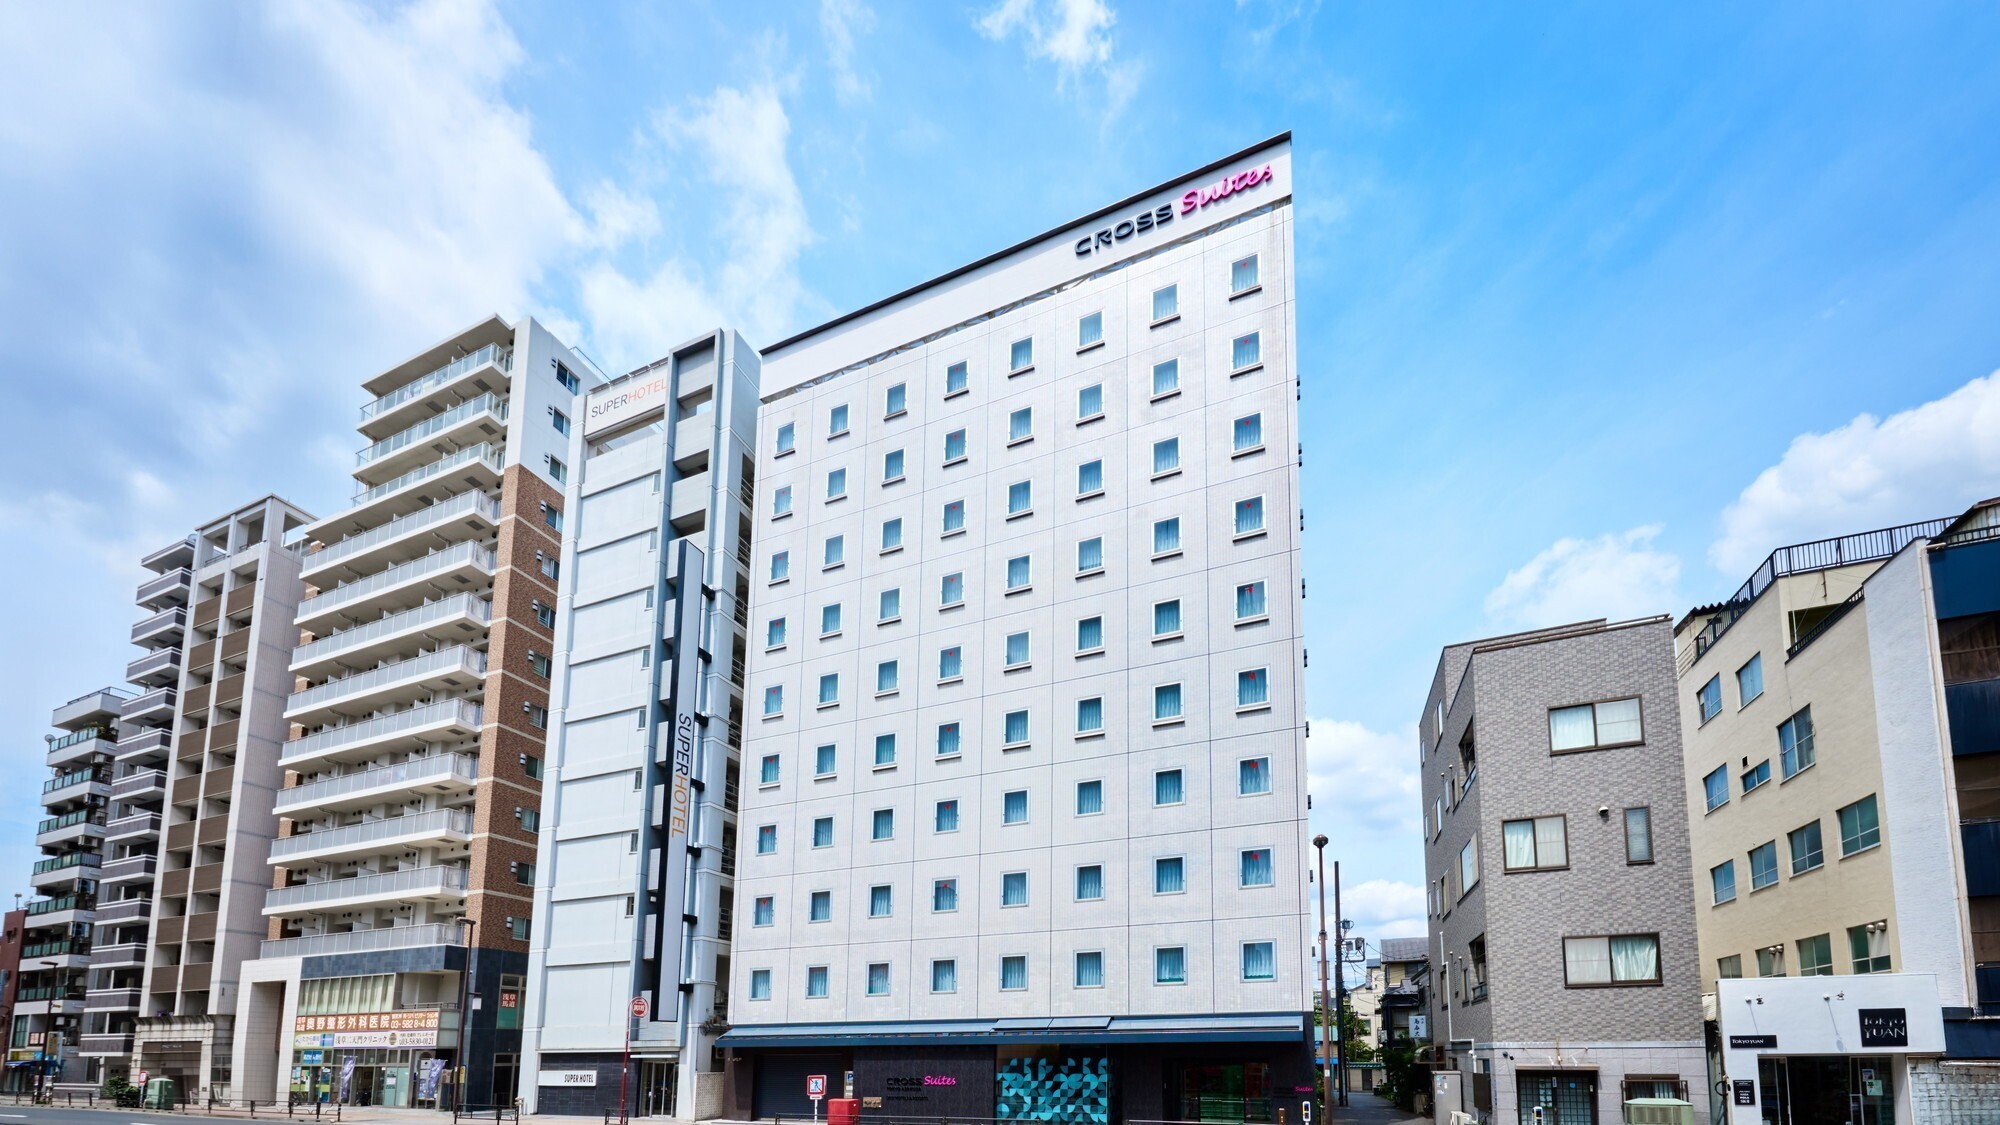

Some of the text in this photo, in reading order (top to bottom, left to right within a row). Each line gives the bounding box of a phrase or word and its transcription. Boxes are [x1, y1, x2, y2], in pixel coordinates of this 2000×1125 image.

[1074, 163, 1273, 257] CROSS Suites
[1864, 1027, 1905, 1039] YUAN
[564, 1074, 594, 1083] SUPER HOTEL
[886, 1075, 956, 1086] CROSS Suites
